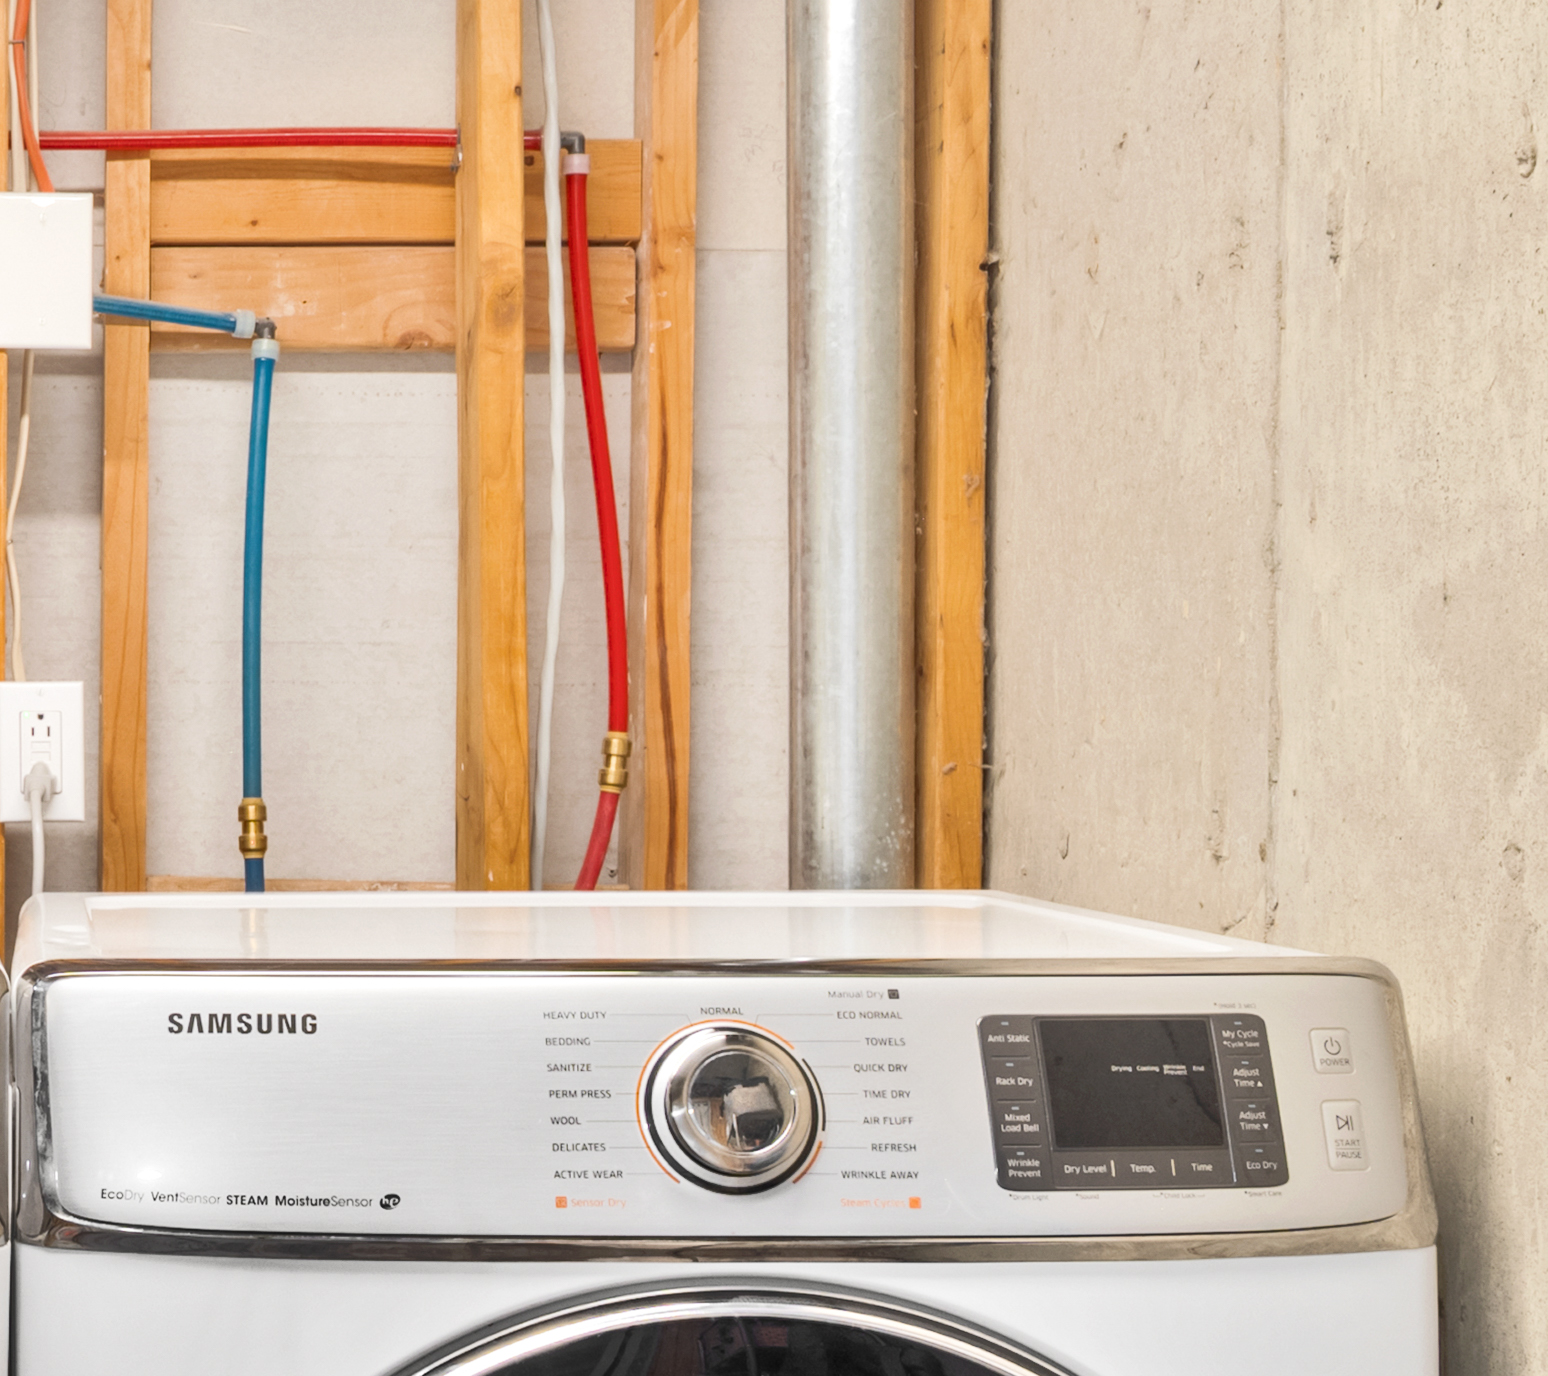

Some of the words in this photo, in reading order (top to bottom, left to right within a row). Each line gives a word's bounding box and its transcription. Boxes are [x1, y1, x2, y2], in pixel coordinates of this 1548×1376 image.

[828, 990, 863, 999] Manual
[866, 991, 884, 1000] Dry
[543, 1011, 577, 1020] HEAVY
[580, 1011, 607, 1019] DUTY
[700, 1007, 743, 1015] NORMAL
[837, 1011, 856, 1020] ECO
[859, 1011, 902, 1020] NORMAL
[168, 1013, 317, 1035] SAMSUNG
[1007, 1034, 1030, 1043] Static
[1222, 1030, 1235, 1039] My
[1237, 1030, 1258, 1039] Cycle
[545, 1038, 591, 1046] BEDDING
[865, 1038, 906, 1046] TOWELS
[1320, 1058, 1350, 1066] POWER
[547, 1063, 592, 1072] SANITIZE
[854, 1063, 885, 1072] QUICK
[888, 1064, 908, 1072] DRY
[1233, 1068, 1260, 1077] Adjust
[996, 1077, 1015, 1085] Rack
[1018, 1077, 1033, 1087] Dry
[1234, 1079, 1254, 1087] Time
[549, 1090, 577, 1099] PERM
[581, 1090, 611, 1099] PRESS
[863, 1090, 887, 1099] TIME
[891, 1090, 911, 1099] DRY
[1005, 1114, 1030, 1122] Mixed
[1239, 1111, 1266, 1120] Adjust
[550, 1117, 581, 1125] WOOL
[863, 1117, 880, 1125] AIR
[883, 1117, 913, 1125] FLUFF
[1001, 1124, 1020, 1132] Load
[1023, 1124, 1039, 1132] Bell
[1240, 1122, 1261, 1130] Time
[552, 1143, 606, 1152] DELICATES
[1335, 1139, 1360, 1147] START
[871, 1144, 917, 1152] REFRESH
[1336, 1151, 1362, 1159] PAUSE
[1007, 1159, 1040, 1167] Wrinkle
[1191, 1163, 1213, 1172] Time
[1246, 1161, 1261, 1169] Eco
[1263, 1161, 1277, 1170] Dry
[1008, 1169, 1041, 1177] Prevent
[1064, 1165, 1080, 1174] Dry
[1083, 1164, 1107, 1173] Level
[554, 1170, 589, 1179] ACTIVE
[593, 1171, 623, 1179] WEAR
[841, 1170, 887, 1179] WRINKLE
[890, 1171, 919, 1179] AWAY
[100, 1188, 144, 1203] EcoDry
[151, 1191, 221, 1205] VentSensor
[226, 1195, 268, 1206] STEAM
[275, 1195, 373, 1208] MoistureSensor
[571, 1199, 605, 1207] Sensor
[608, 1198, 626, 1209] Dry
[841, 1199, 871, 1207] Steam
